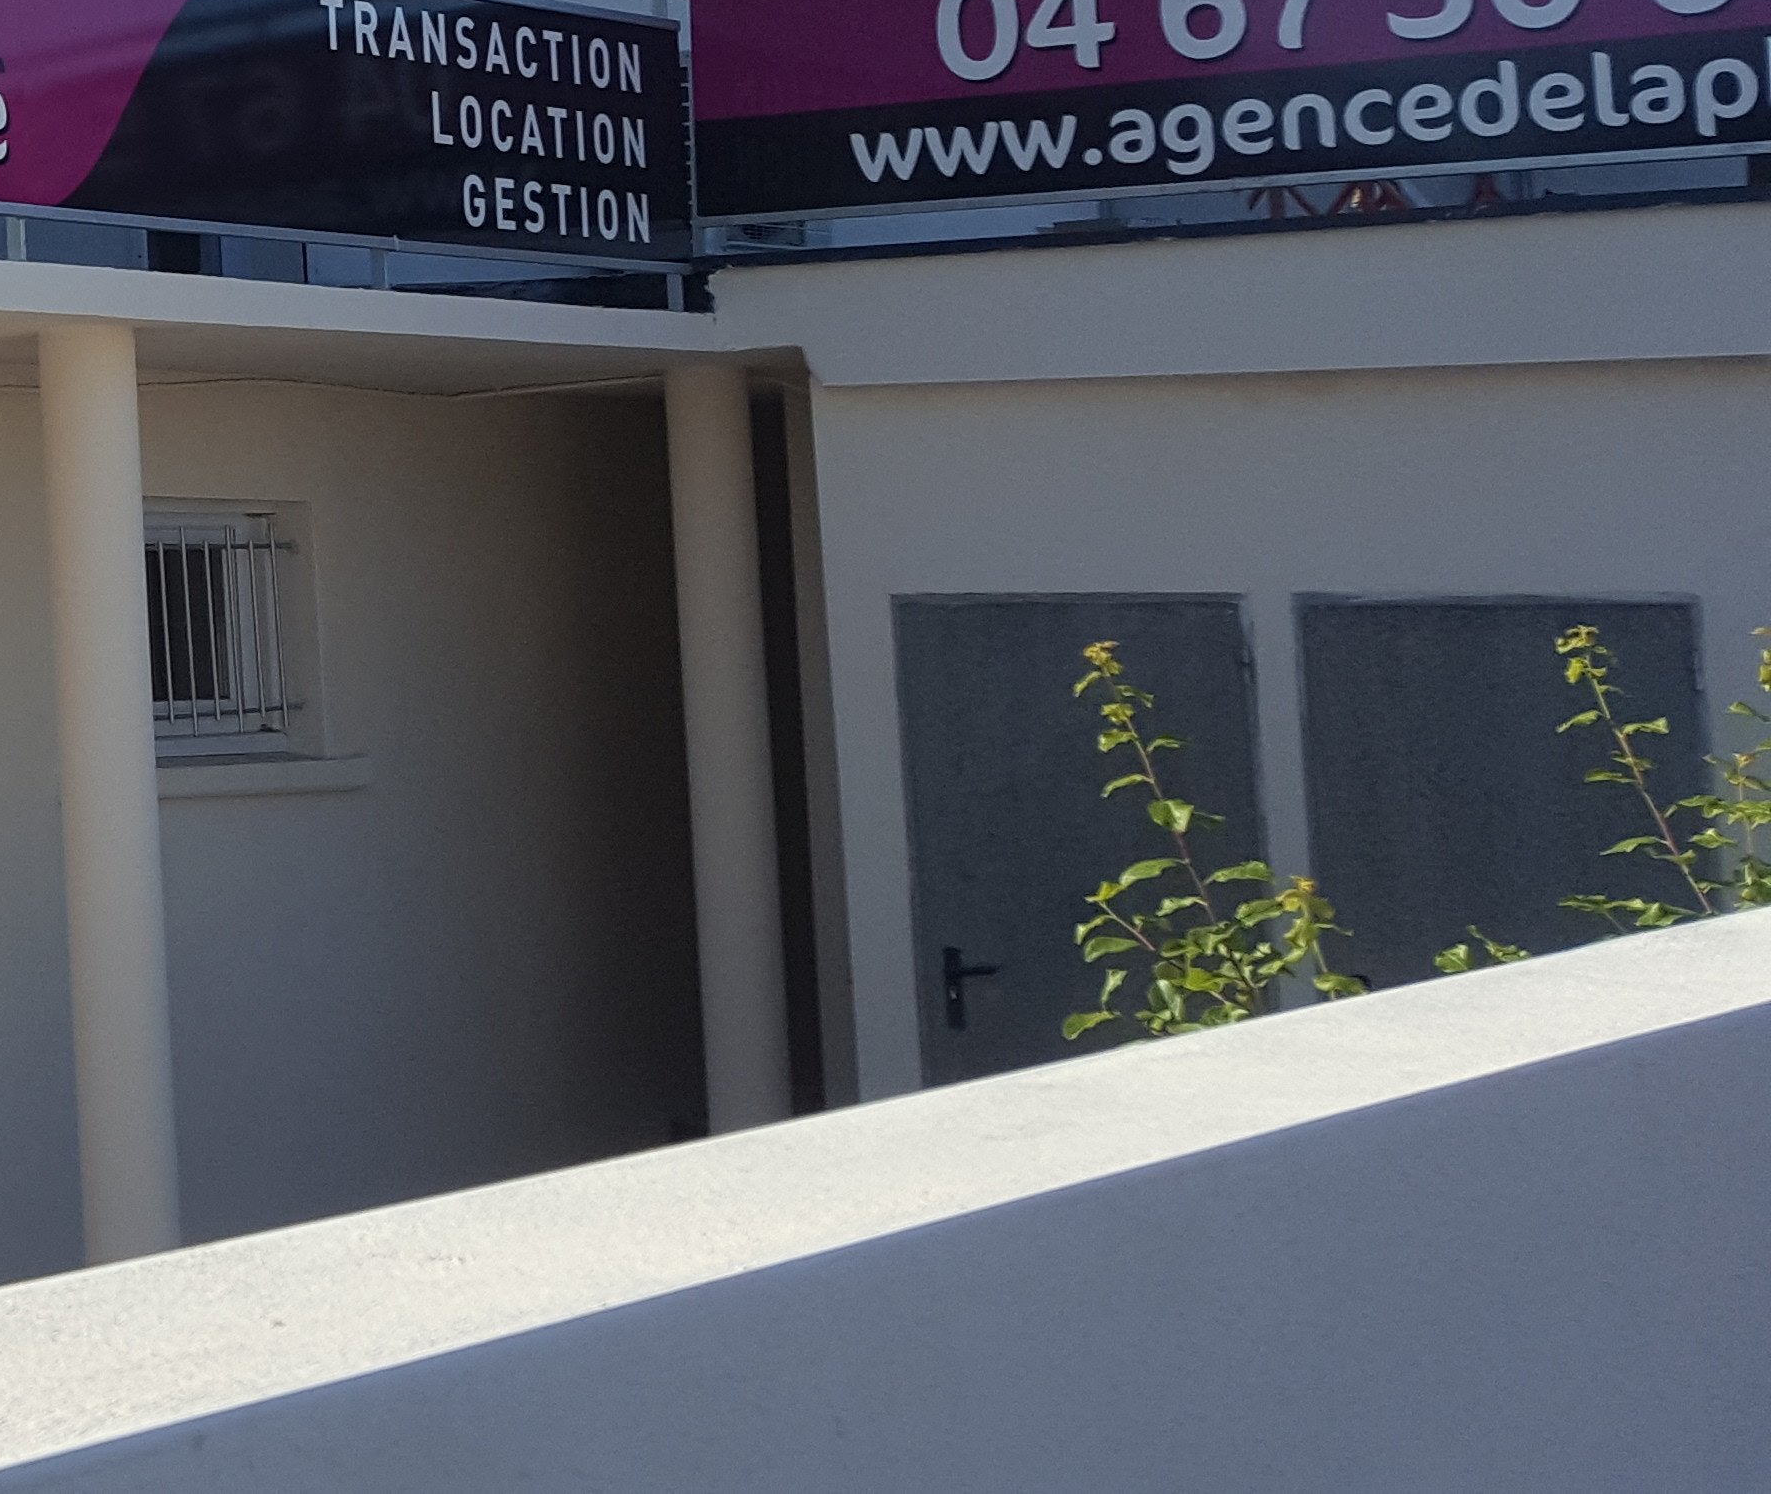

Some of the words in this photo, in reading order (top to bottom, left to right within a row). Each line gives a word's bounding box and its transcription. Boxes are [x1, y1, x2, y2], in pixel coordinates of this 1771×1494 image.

[431, 91, 647, 169] LOCATION
[849, 36, 1771, 184] www.agencedelap
[462, 174, 651, 245] GESTION
